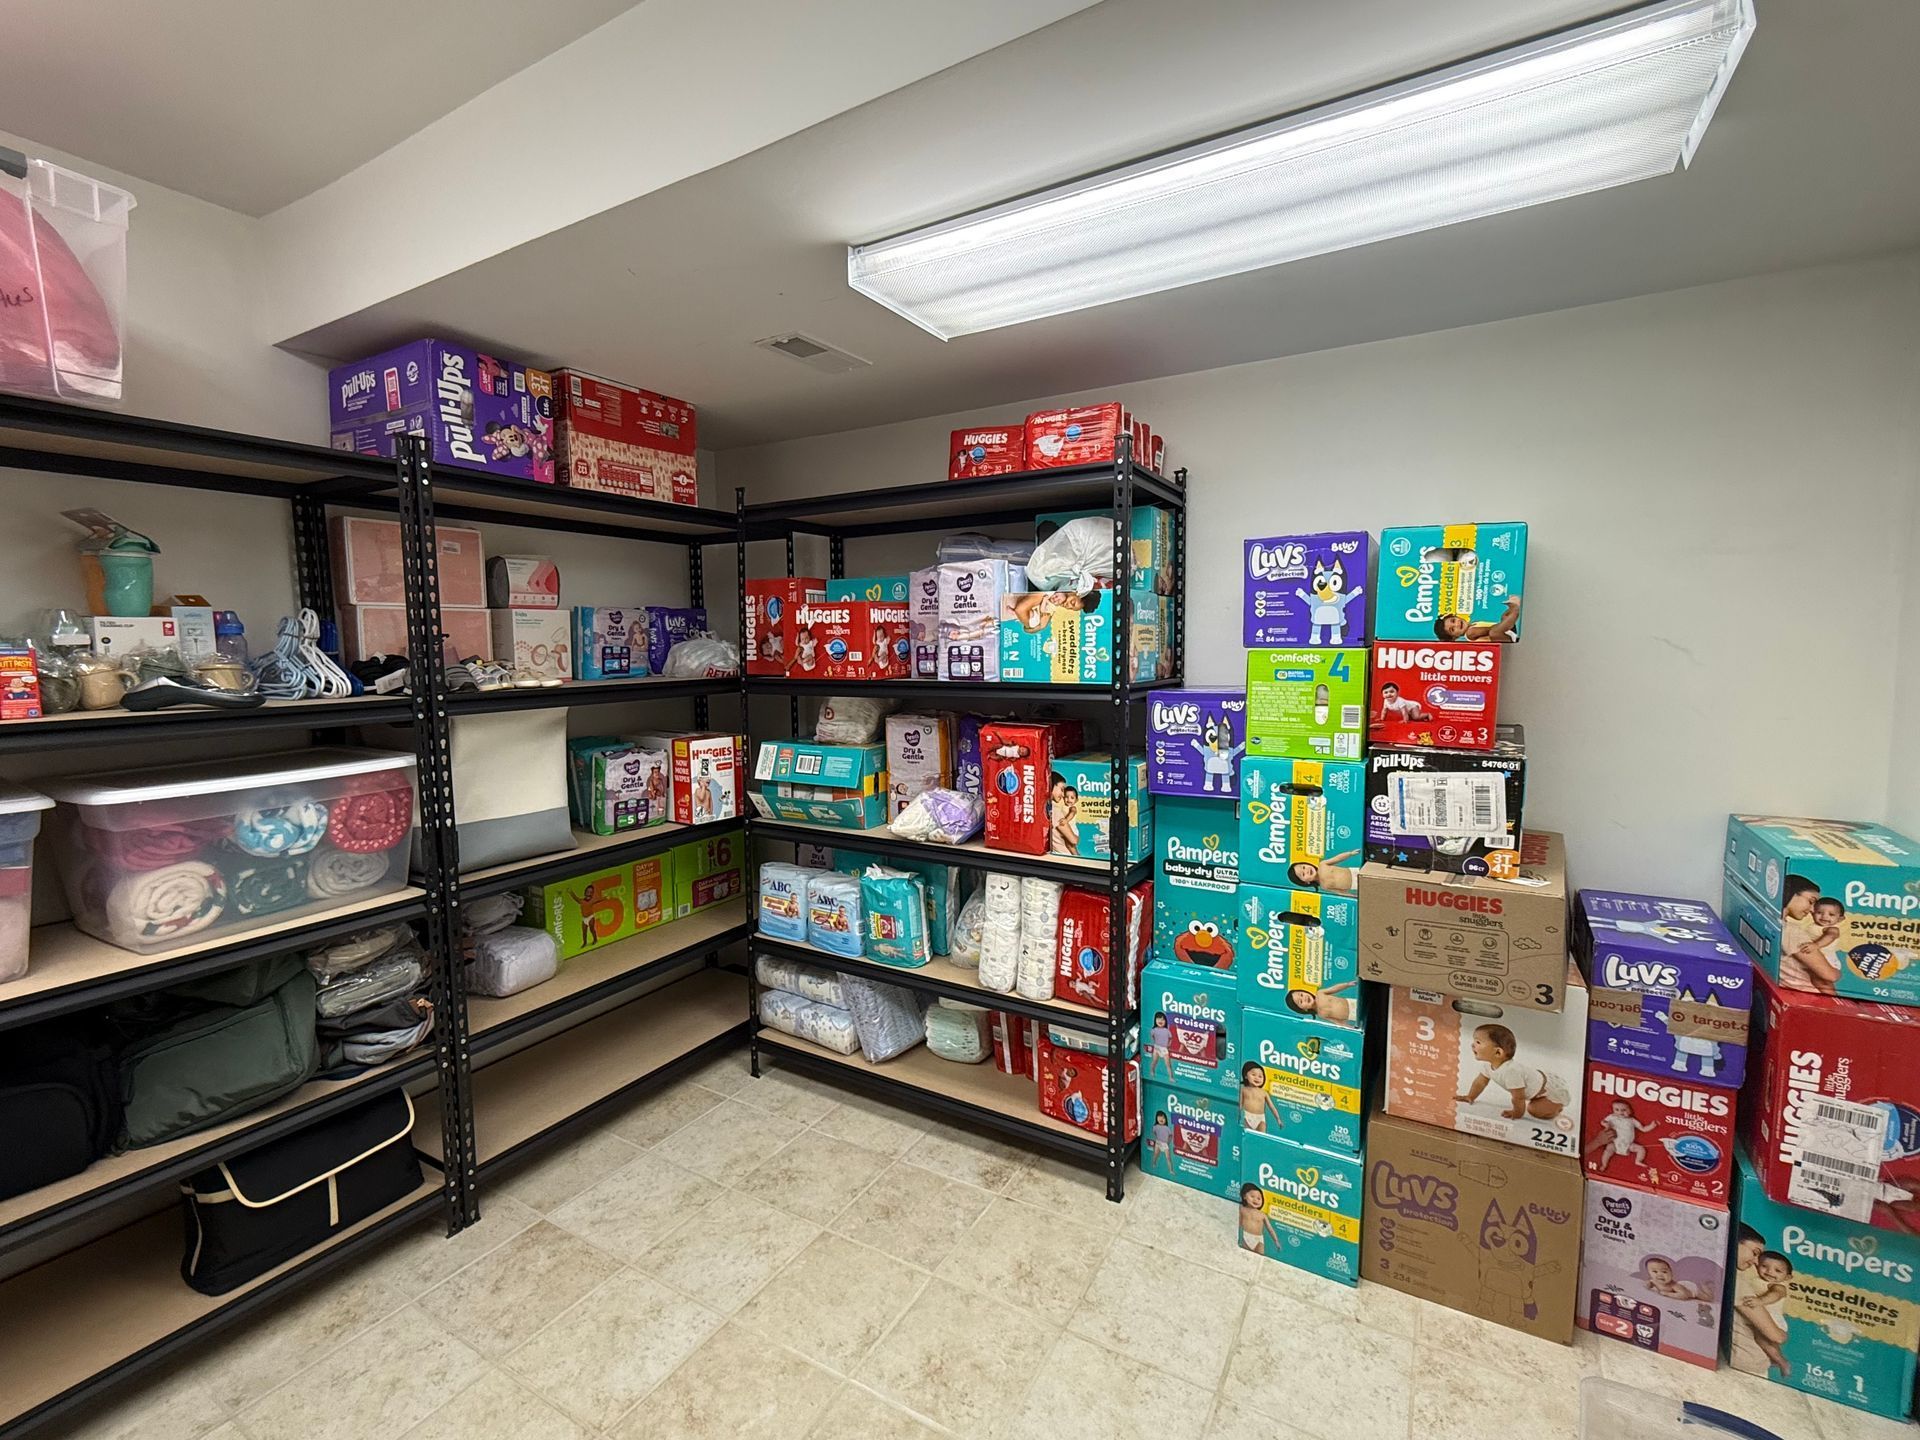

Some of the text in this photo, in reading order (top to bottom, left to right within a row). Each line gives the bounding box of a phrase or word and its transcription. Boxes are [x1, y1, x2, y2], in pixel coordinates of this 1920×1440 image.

[964, 432, 1008, 446] HUGGIES
[1331, 541, 1359, 554] Bluey
[1134, 570, 1144, 581] N
[954, 594, 968, 602] Dry
[796, 608, 850, 624] HUGGIES
[870, 608, 910, 624] HUGGIES
[746, 596, 758, 660] HUGGIES
[1256, 629, 1264, 638] 4
[1010, 650, 1019, 660] N
[1068, 620, 1076, 674] swaddlers
[1084, 615, 1105, 680] Pampers
[1328, 652, 1350, 682] 4
[1377, 648, 1494, 672] HUGGIES
[960, 664, 968, 674] N
[1420, 672, 1492, 684] little movers
[1222, 700, 1245, 711] Bluey
[1478, 728, 1488, 741] 3
[1372, 754, 1424, 773] Pull-Ups
[622, 776, 632, 784] Dry
[1157, 771, 1164, 780] 5
[1023, 764, 1034, 824] HUGGIES
[628, 815, 634, 824] 5
[1258, 782, 1290, 863] Pampers
[1294, 800, 1304, 851] swaddlers
[717, 838, 732, 866] 6
[1168, 836, 1238, 866] Pampers
[1493, 854, 1513, 863] 3T
[1492, 864, 1511, 874] 4T
[770, 881, 791, 894] ABC
[1190, 880, 1230, 890] LEAKPROOF
[592, 874, 624, 938] 5
[816, 895, 839, 906] ABC
[1406, 888, 1503, 914] HUGGIES
[1459, 914, 1504, 930] snugglers
[1866, 932, 1894, 941] best
[1060, 917, 1075, 977] HUGGIES
[1256, 910, 1288, 990] Pampers
[1292, 929, 1302, 979] swaddlers
[1858, 953, 1878, 972] You
[1868, 952, 1891, 980] Thank
[1606, 956, 1678, 988] Luvs
[1708, 974, 1744, 989] Bluey
[1535, 984, 1554, 1006] 3
[1872, 987, 1888, 996] 96
[1162, 992, 1226, 1022] Pampers
[1174, 1018, 1214, 1032] cruisers
[1416, 1016, 1435, 1040] 3
[1227, 1042, 1235, 1054] 5
[1608, 1038, 1618, 1047] 2
[1260, 1040, 1340, 1080] Pampers
[1620, 1048, 1635, 1056] 104
[1226, 1070, 1236, 1078] 56
[1273, 1072, 1324, 1092] swaddlers
[1825, 1074, 1834, 1091] little
[1340, 1095, 1348, 1104] 4
[1592, 1071, 1729, 1116] HUGGIES
[1168, 1094, 1226, 1126] Pampers
[1684, 1112, 1704, 1122] little
[1178, 1118, 1216, 1132] cruisers
[1335, 1125, 1348, 1134] 120
[1666, 1114, 1728, 1136] snugglers
[1531, 1128, 1568, 1148] 222
[1232, 1146, 1240, 1156] 5
[1534, 1142, 1564, 1152] DIAPERS
[1259, 1162, 1339, 1208] Pampers
[1712, 1180, 1724, 1194] 2
[1272, 1196, 1323, 1218] swaddlers
[1606, 1200, 1630, 1210] Parent's
[1404, 1208, 1453, 1226] protection
[1529, 1203, 1571, 1224] Bluey
[1339, 1224, 1346, 1233] 4
[1594, 1222, 1636, 1240] Gentle
[1598, 1216, 1632, 1232] Dry &
[1333, 1252, 1346, 1262] 120
[1783, 1226, 1913, 1284] Pampers
[1380, 1258, 1390, 1270] 3
[1393, 1272, 1412, 1283] 234
[1789, 1282, 1899, 1318] swaddlers
[1806, 1296, 1836, 1310] best
[1841, 1304, 1896, 1326] dryness
[1813, 1306, 1876, 1328] comfort ever
[1615, 1320, 1628, 1335] 2
[1806, 1362, 1864, 1393] 164 1
